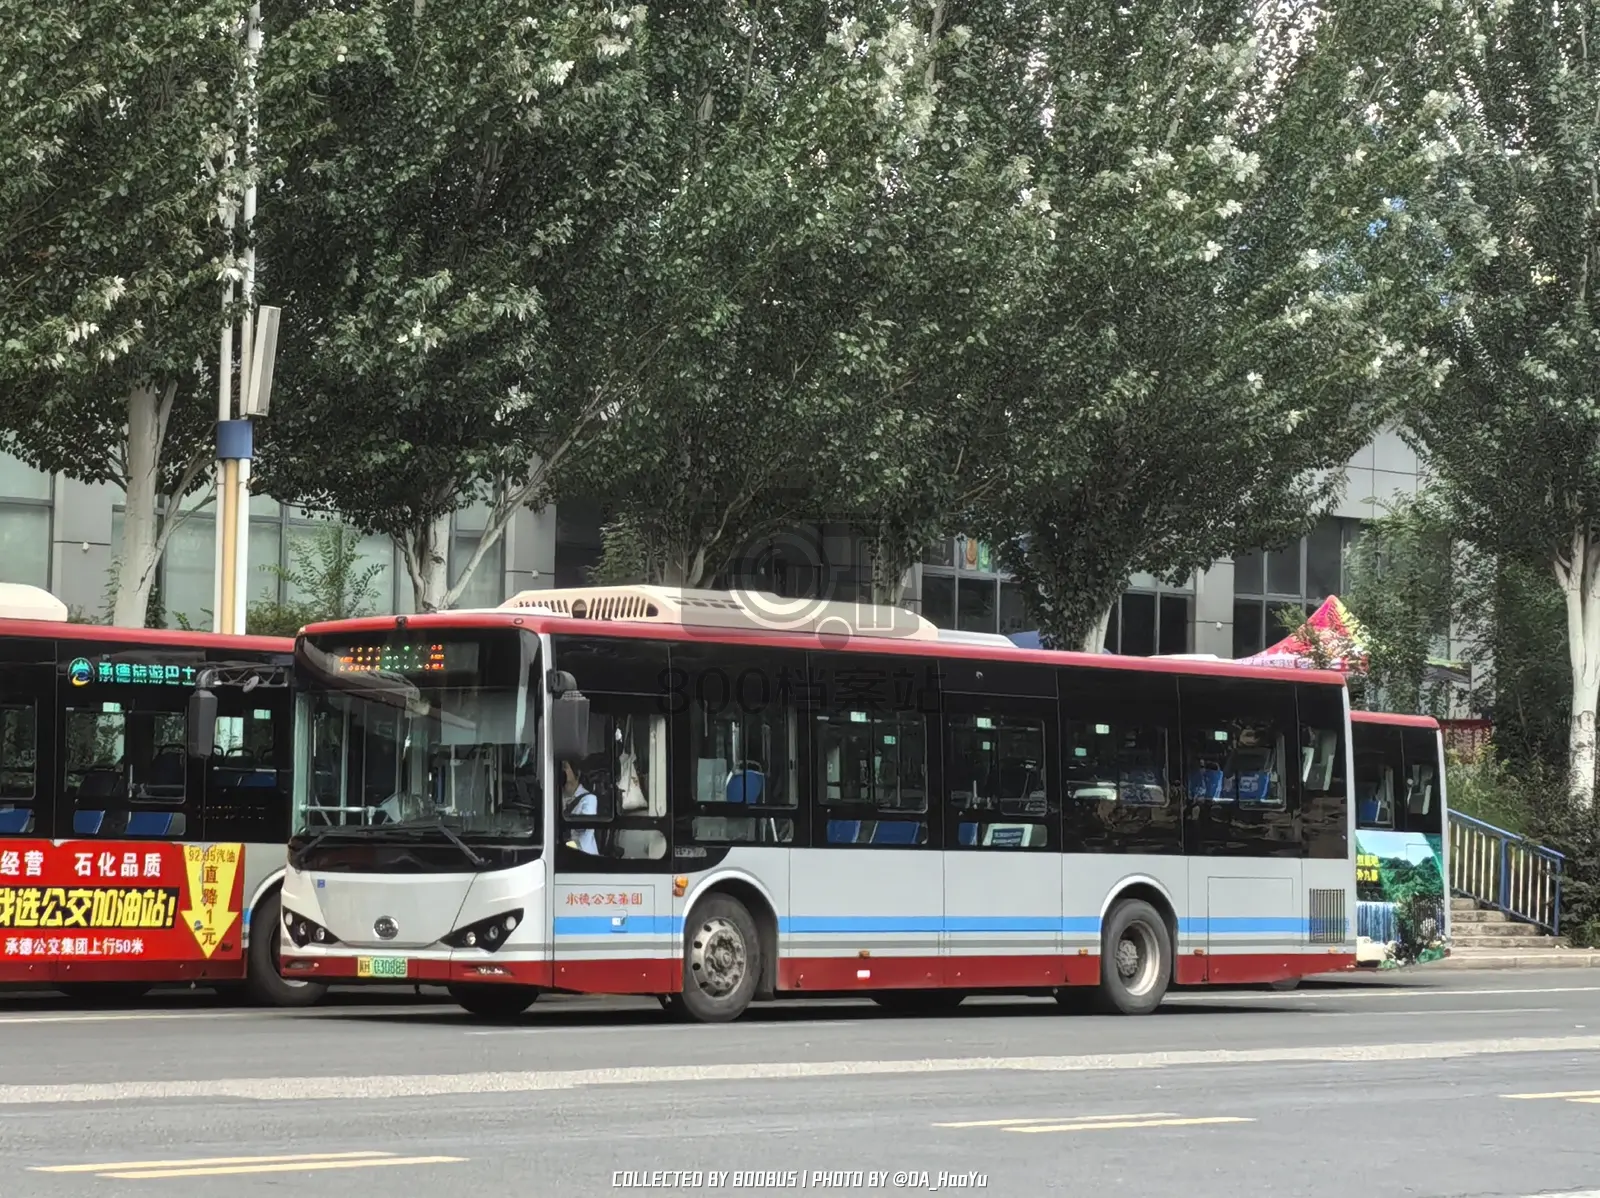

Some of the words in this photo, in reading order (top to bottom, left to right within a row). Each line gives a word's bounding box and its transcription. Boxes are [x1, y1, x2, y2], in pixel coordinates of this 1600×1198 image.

[0, 850, 43, 876] 经营
[74, 852, 161, 877] 石化品质
[5, 937, 144, 955] 承德公交集团上行50米
